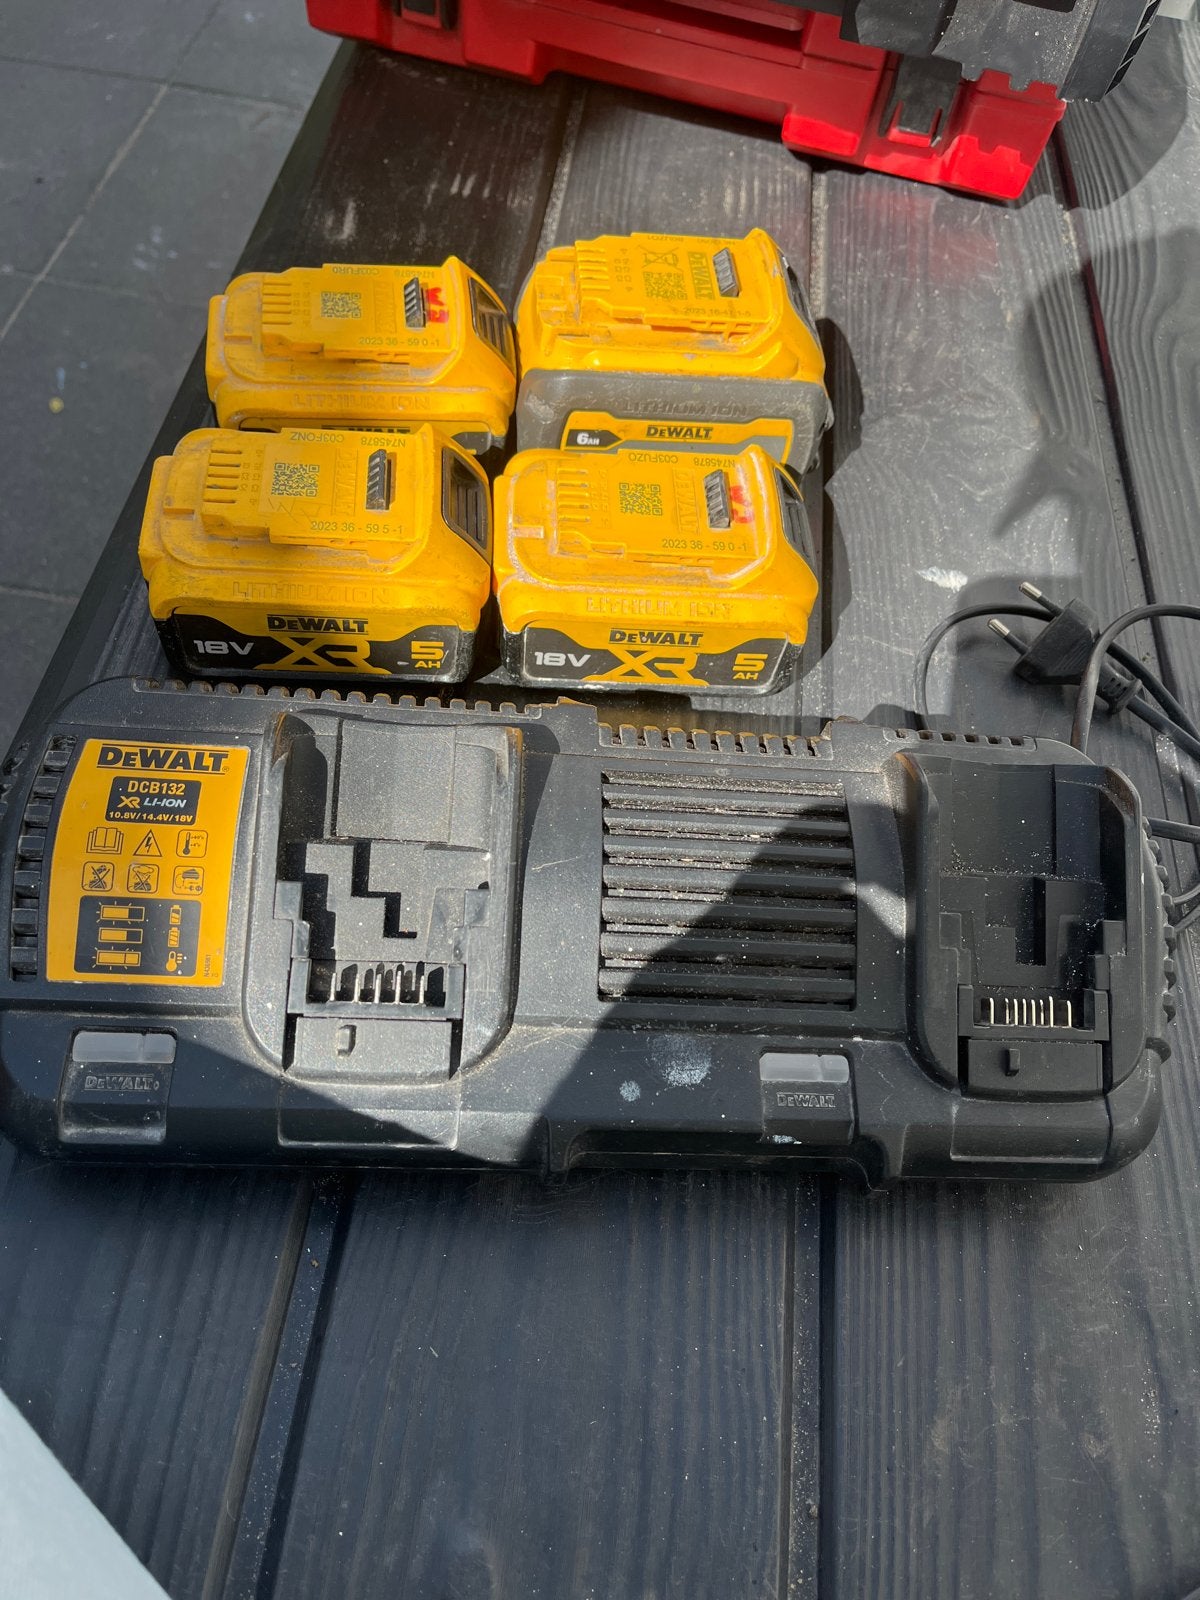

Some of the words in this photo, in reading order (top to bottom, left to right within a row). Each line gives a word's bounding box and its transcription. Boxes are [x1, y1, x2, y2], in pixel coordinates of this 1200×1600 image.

[358, 336, 384, 346] 2023
[624, 401, 706, 417] LITHIUM
[711, 402, 749, 418] ION
[361, 436, 406, 448] N745878
[693, 457, 736, 468] N745878
[310, 520, 338, 531] 2023
[341, 521, 355, 532] 36
[366, 523, 380, 534] 59
[382, 524, 391, 534] 5
[662, 538, 687, 549] 2023
[689, 540, 703, 550] 36
[712, 541, 726, 551] 59
[232, 581, 343, 601] LITHIUM
[348, 585, 390, 605] ION
[587, 596, 683, 617] LITHIUM
[193, 639, 254, 656] 18V
[252, 637, 393, 674] XR
[410, 641, 445, 663] 5
[414, 661, 441, 669] AH
[534, 651, 591, 668] 18V
[581, 649, 709, 687] XR
[732, 653, 768, 672] 5
[732, 671, 760, 681] AH
[127, 780, 187, 796] DCB132
[117, 796, 141, 809] XR
[143, 797, 187, 809] LI-ION
[109, 811, 193, 823] 10.8V/14.4V/18V
